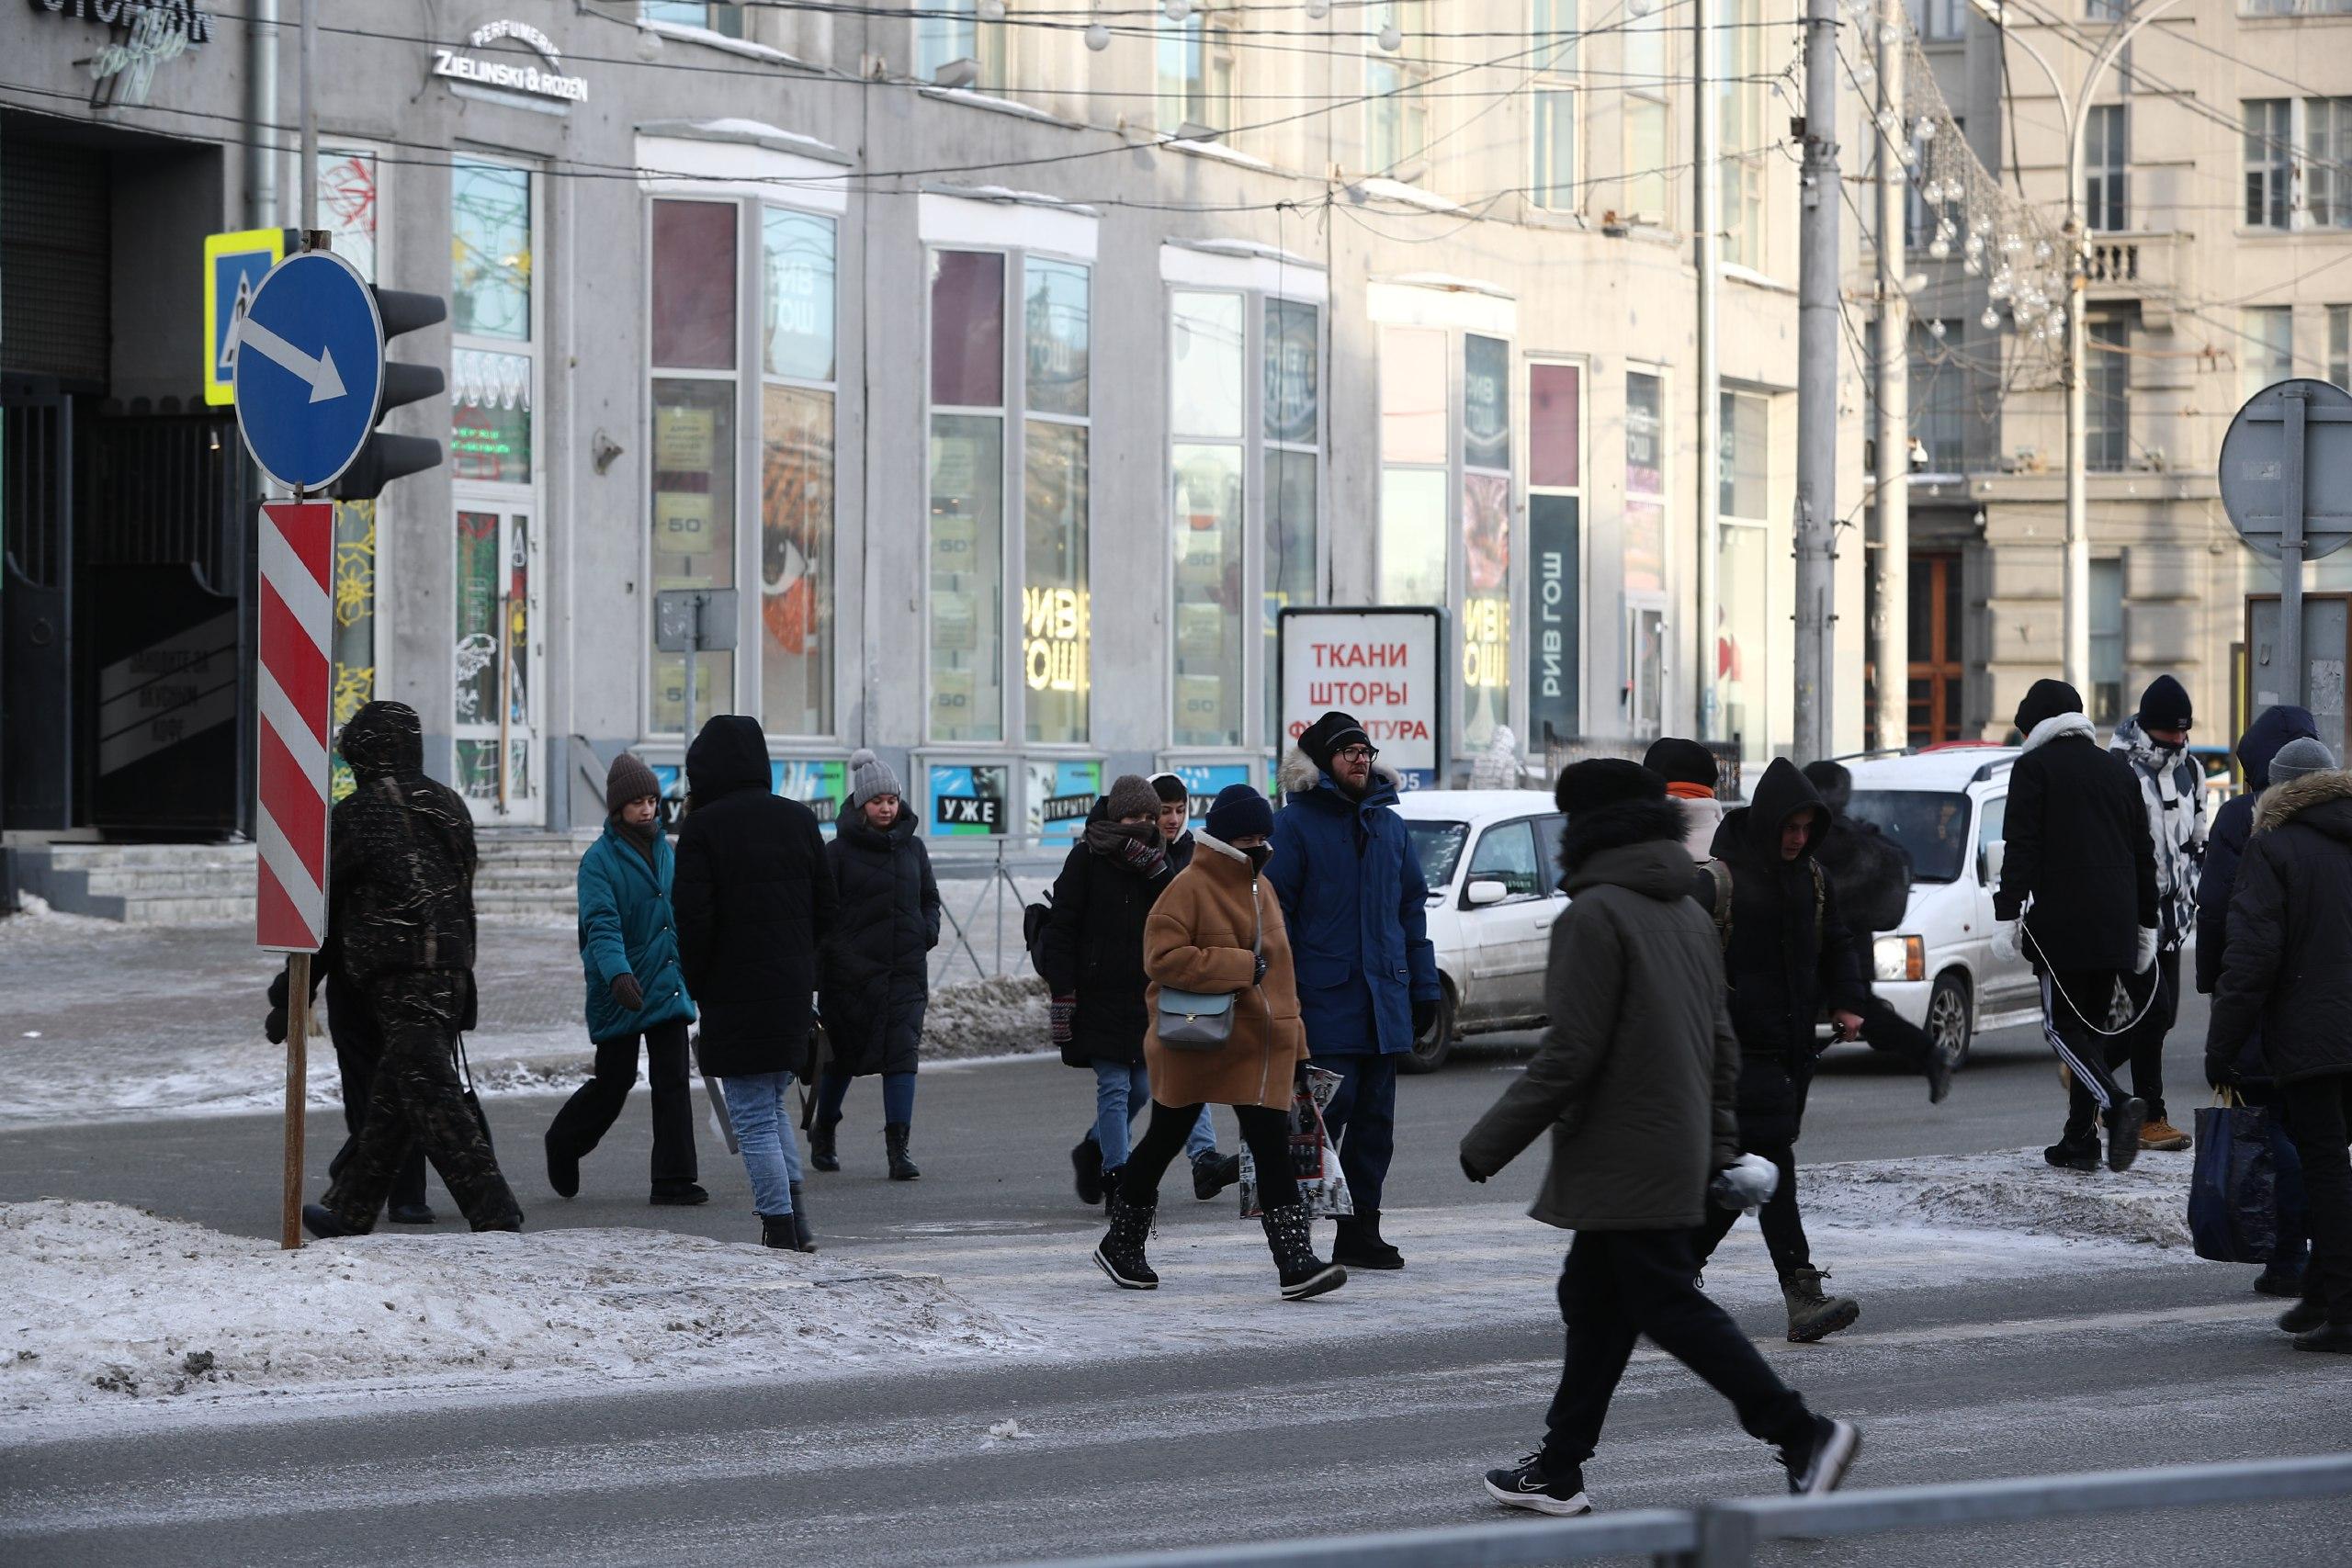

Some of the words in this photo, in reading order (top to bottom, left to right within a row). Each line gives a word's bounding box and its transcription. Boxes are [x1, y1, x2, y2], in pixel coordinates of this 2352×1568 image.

[434, 49, 524, 89] ZIELINSKI
[540, 73, 589, 103] ROZEN
[668, 518, 700, 533] 50
[1543, 551, 1562, 623] ГОШ
[1464, 598, 1498, 641] ИВ
[1022, 638, 1078, 691] ОШ
[1311, 644, 1408, 668] ТКАНИ
[1543, 629, 1562, 697] РИВ
[1309, 682, 1408, 705] ШТОРЫ
[1289, 720, 1429, 740] ФТУРА
[944, 798, 996, 823] УЖЕ
